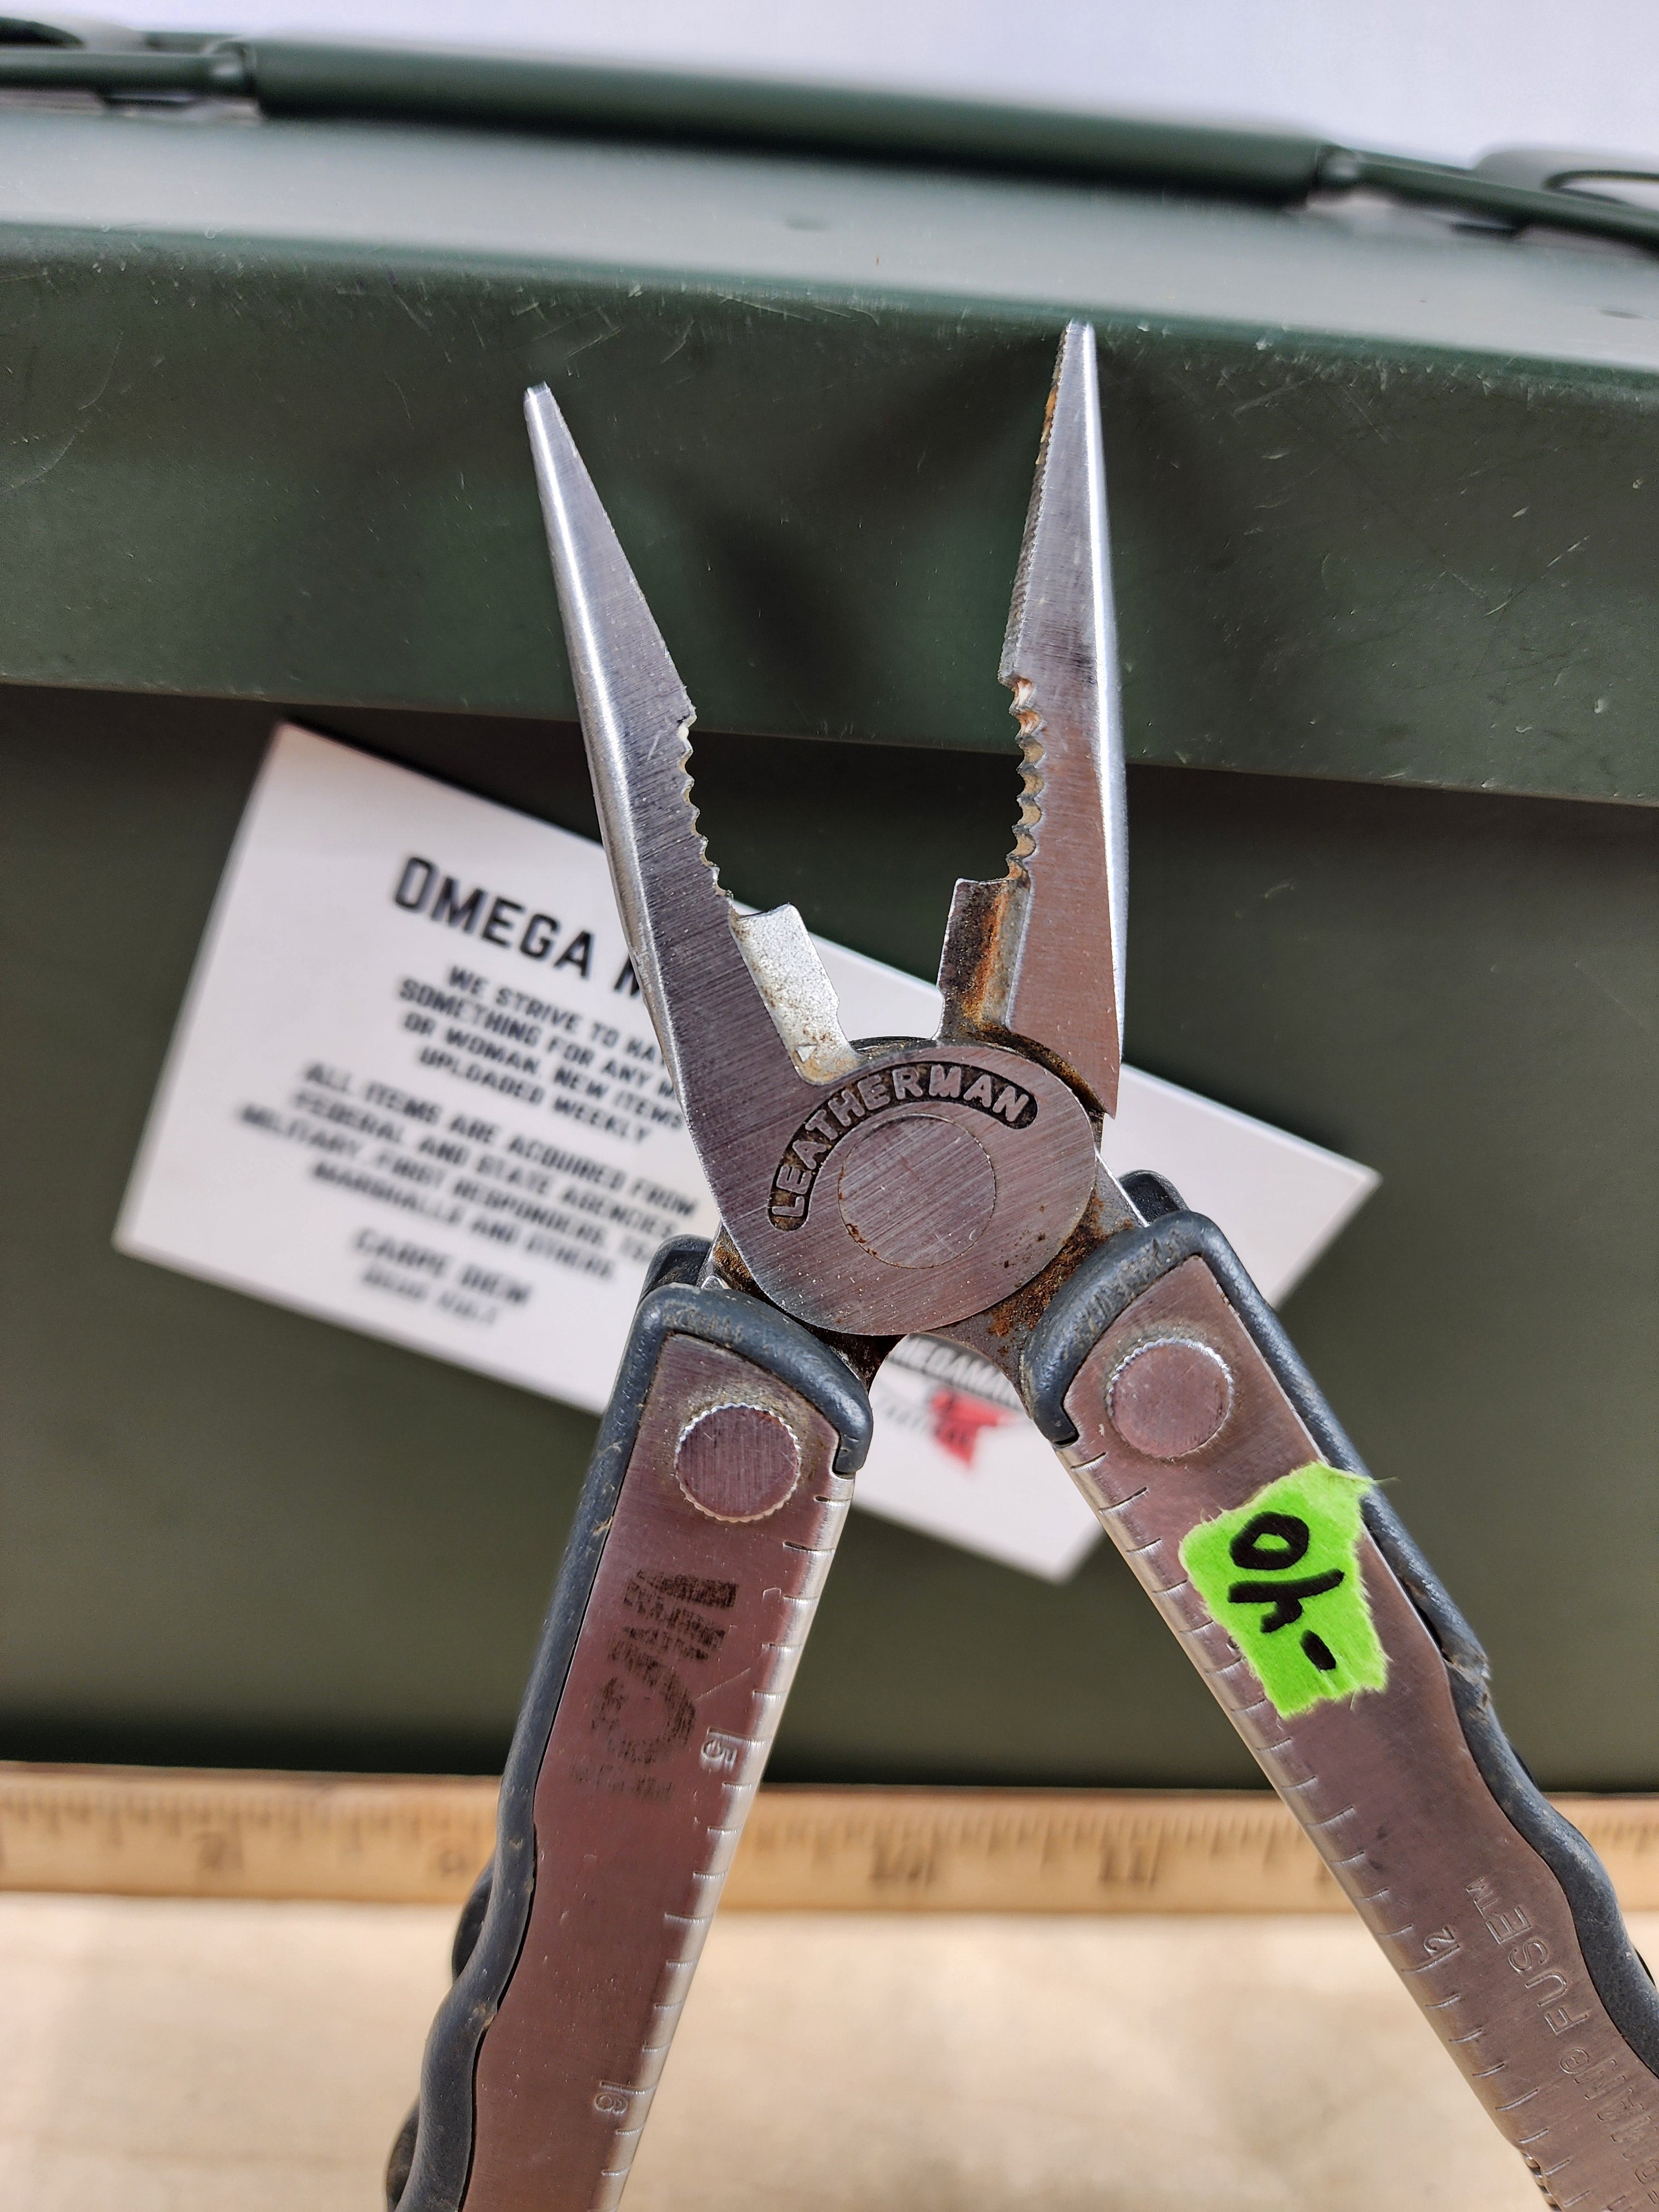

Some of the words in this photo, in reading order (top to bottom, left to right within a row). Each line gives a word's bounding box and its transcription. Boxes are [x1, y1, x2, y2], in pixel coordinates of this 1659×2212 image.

[393, 856, 596, 979] OMEGA
[399, 978, 542, 1046] SOMETHING
[549, 1036, 594, 1067] FOR
[601, 1058, 654, 1088] ANY
[404, 1012, 436, 1036] OR
[554, 1066, 608, 1099] NEW
[615, 1088, 683, 1131] ITEMS
[448, 965, 487, 995] WE
[497, 988, 582, 1031] STRIVE
[591, 1021, 619, 1048] TO
[625, 1037, 664, 1066] HA
[420, 1047, 544, 1106] UPLOADED
[554, 1096, 650, 1143] WEEKLY
[771, 1064, 1030, 1218] LEATHERMAN
